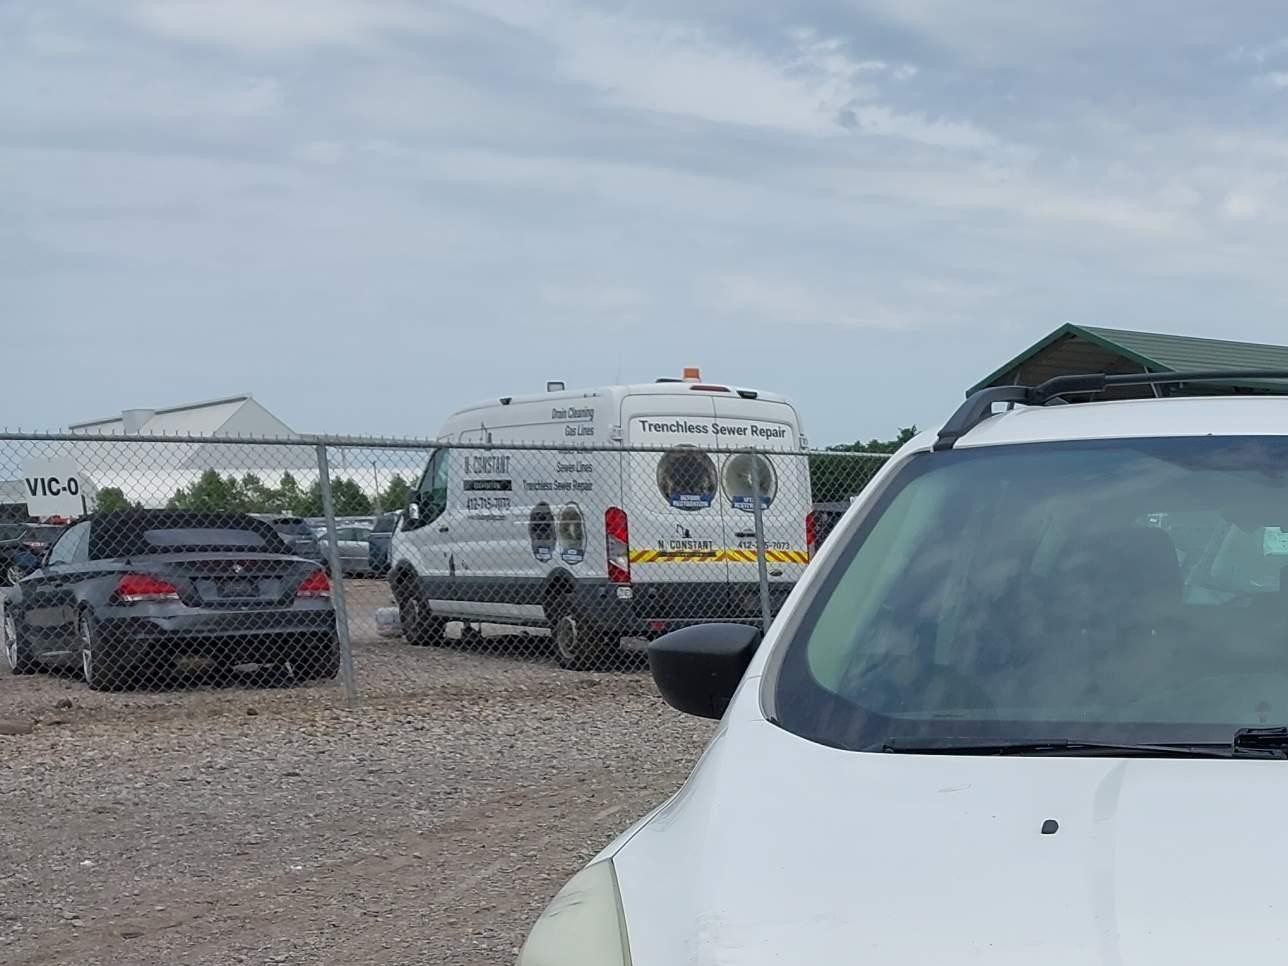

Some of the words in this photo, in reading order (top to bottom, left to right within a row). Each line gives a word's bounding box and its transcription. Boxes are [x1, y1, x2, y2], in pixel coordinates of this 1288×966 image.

[568, 407, 594, 422] Cleaning
[577, 424, 594, 436] Lines
[639, 420, 708, 434] Trenchless
[711, 422, 748, 436] Sewer
[750, 425, 786, 440] Repair
[670, 539, 713, 550] CONSTANT
